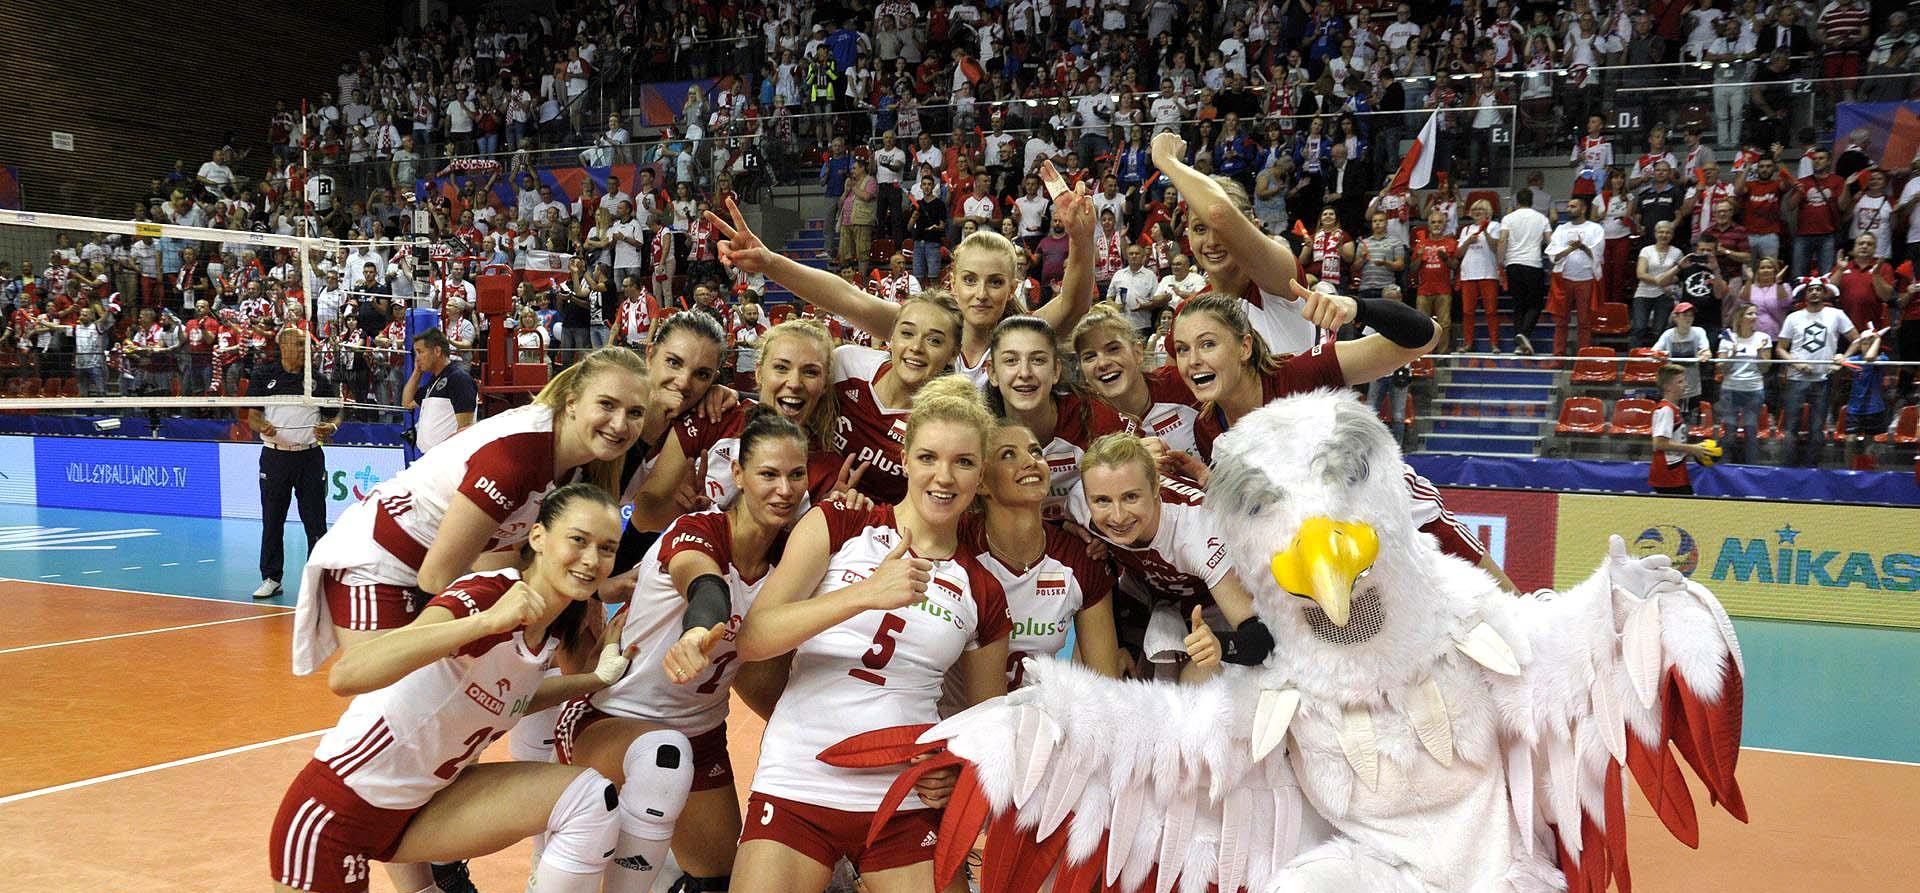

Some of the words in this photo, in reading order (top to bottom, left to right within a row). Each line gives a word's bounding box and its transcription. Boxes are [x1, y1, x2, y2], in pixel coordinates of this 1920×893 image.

[1619, 112, 1640, 128] D1
[1492, 128, 1509, 143] E1
[745, 154, 758, 167] F1
[320, 181, 330, 194] F1
[857, 446, 903, 476] plus
[474, 475, 507, 505] plus
[672, 532, 704, 549] plus
[1036, 588, 1066, 597] POLSKA
[908, 596, 953, 623] lus
[1012, 617, 1056, 640] plus
[861, 612, 907, 670] 5
[468, 684, 503, 715] ORLEN
[343, 853, 366, 884] 23
